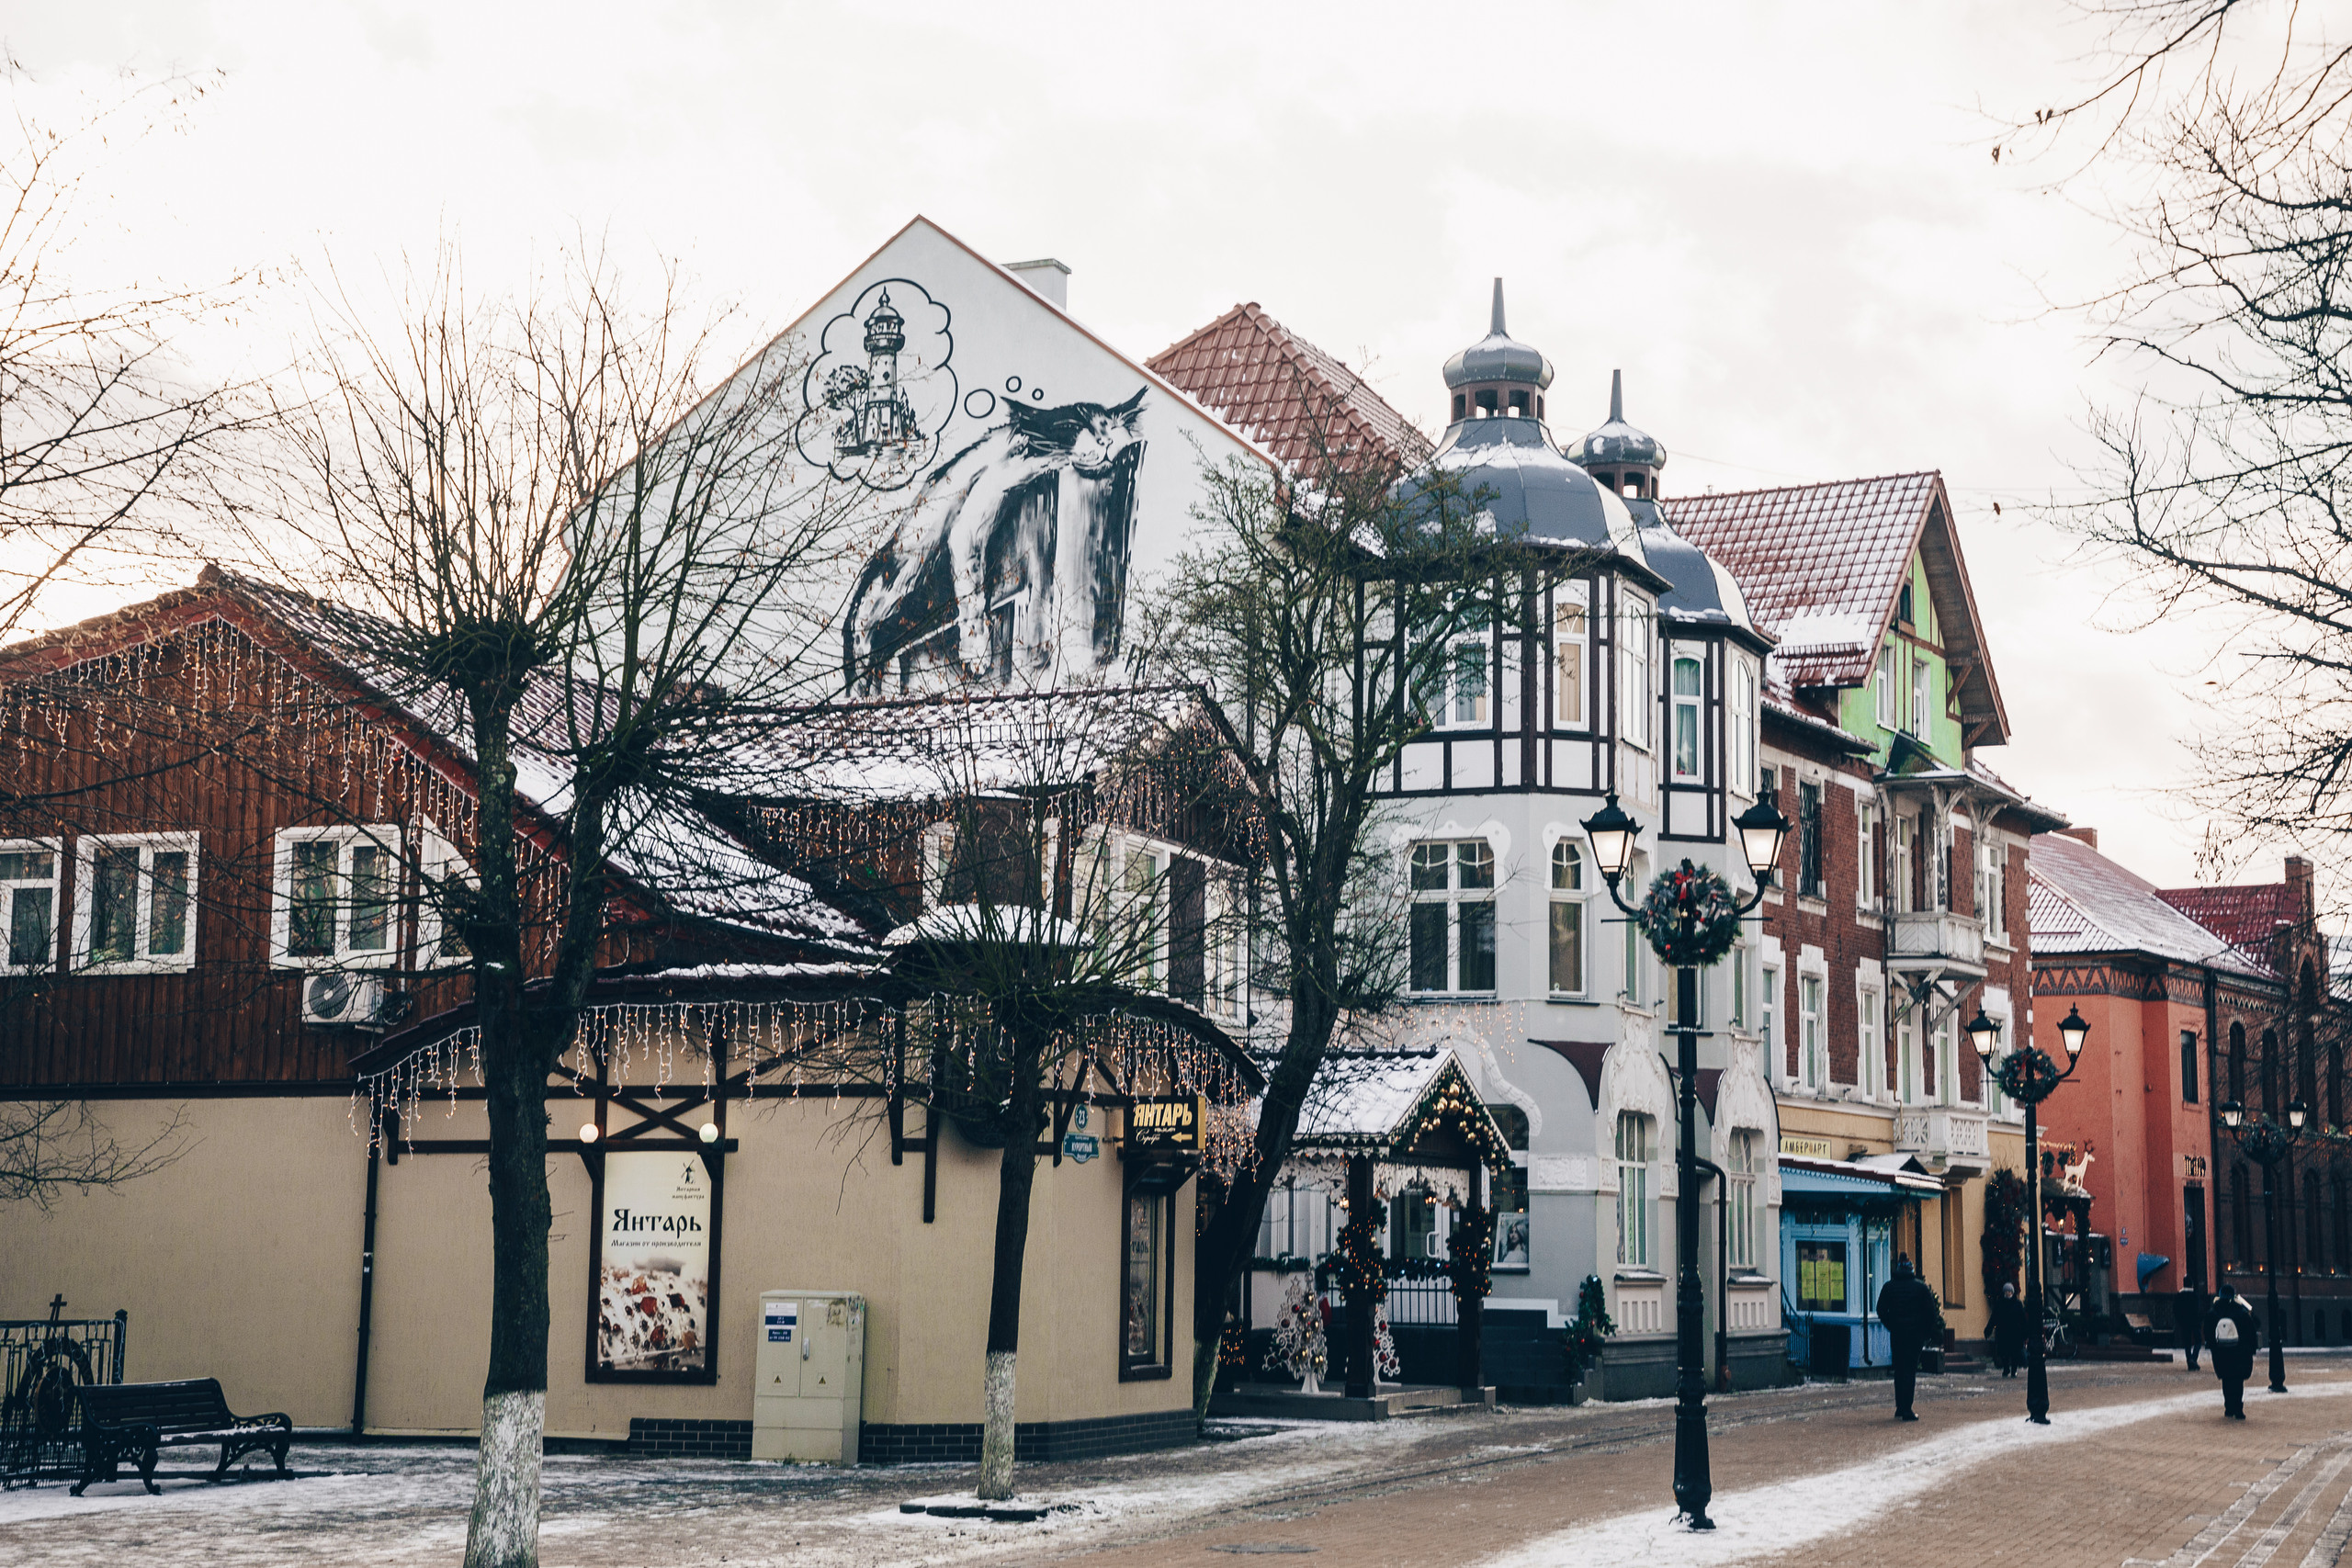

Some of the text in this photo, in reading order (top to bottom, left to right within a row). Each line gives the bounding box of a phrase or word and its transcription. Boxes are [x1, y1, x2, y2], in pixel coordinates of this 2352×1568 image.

[1078, 1109, 1086, 1125] 23
[1133, 1102, 1193, 1127] ЯНТАРЬ
[612, 1208, 702, 1239] Янтарь
[611, 1239, 640, 1247] Магазин
[651, 1240, 702, 1249] производителя
